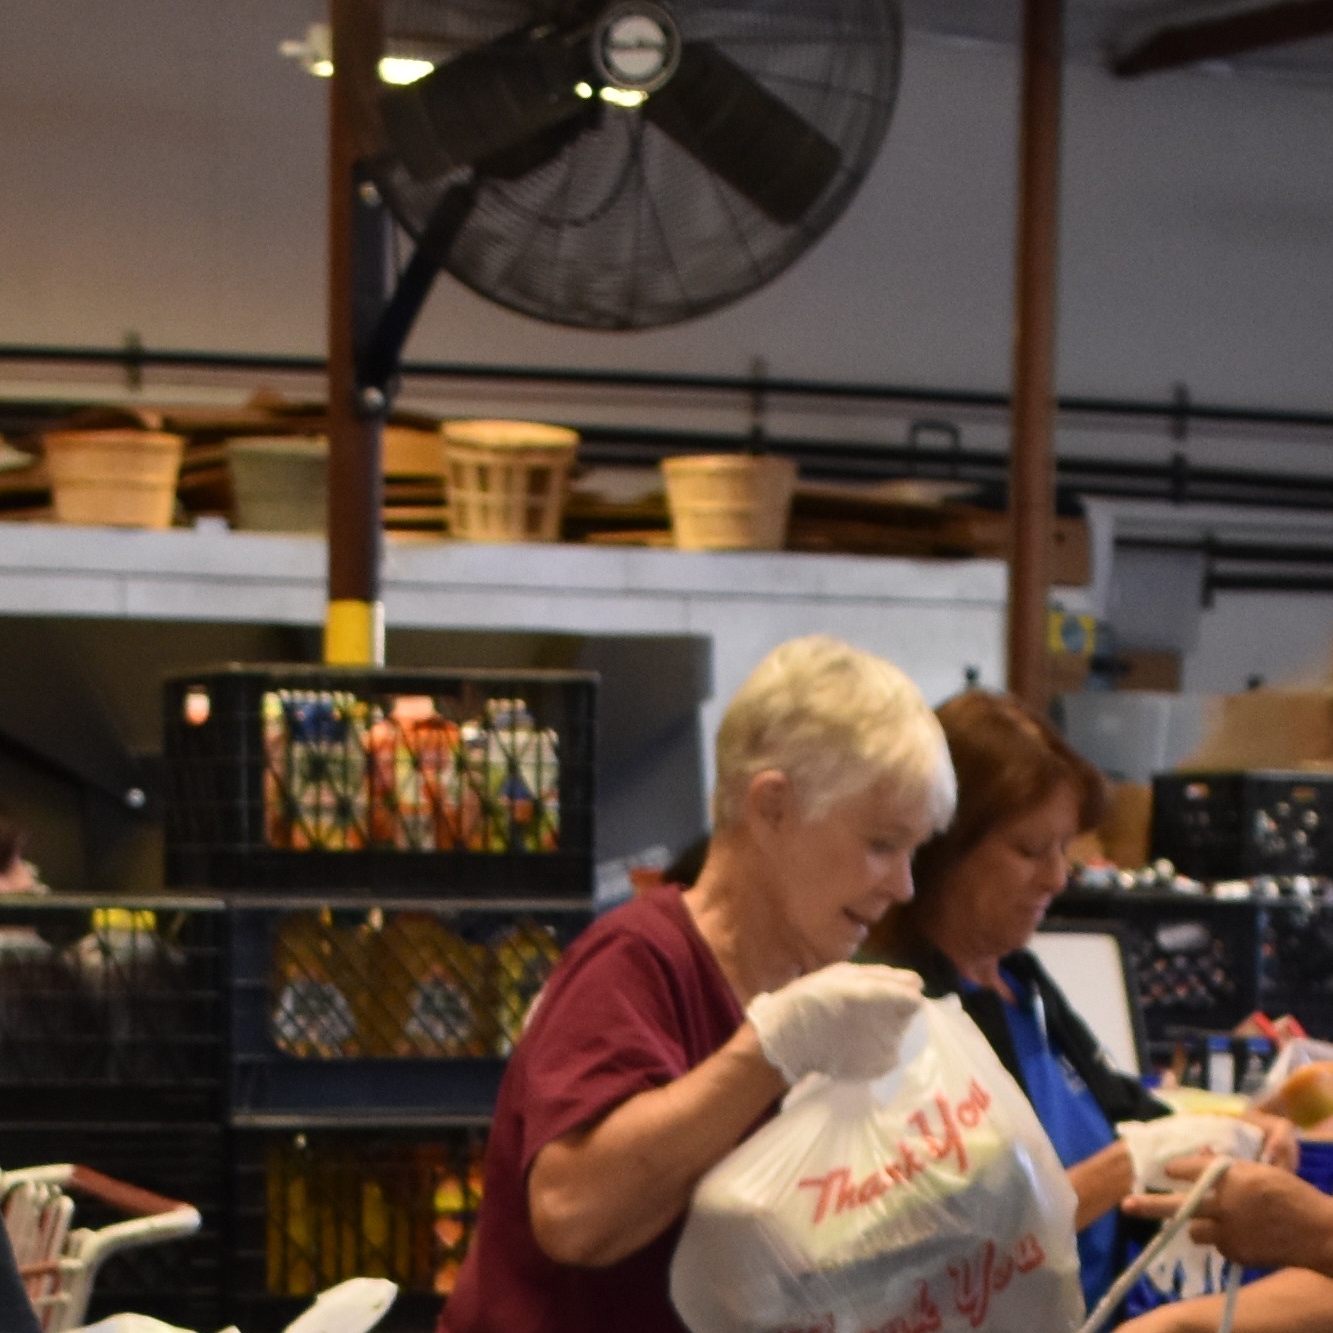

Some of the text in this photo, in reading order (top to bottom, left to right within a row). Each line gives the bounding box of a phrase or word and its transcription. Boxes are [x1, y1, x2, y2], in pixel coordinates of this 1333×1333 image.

[798, 1078, 991, 1225] Thank You
[947, 1232, 1046, 1329] You
